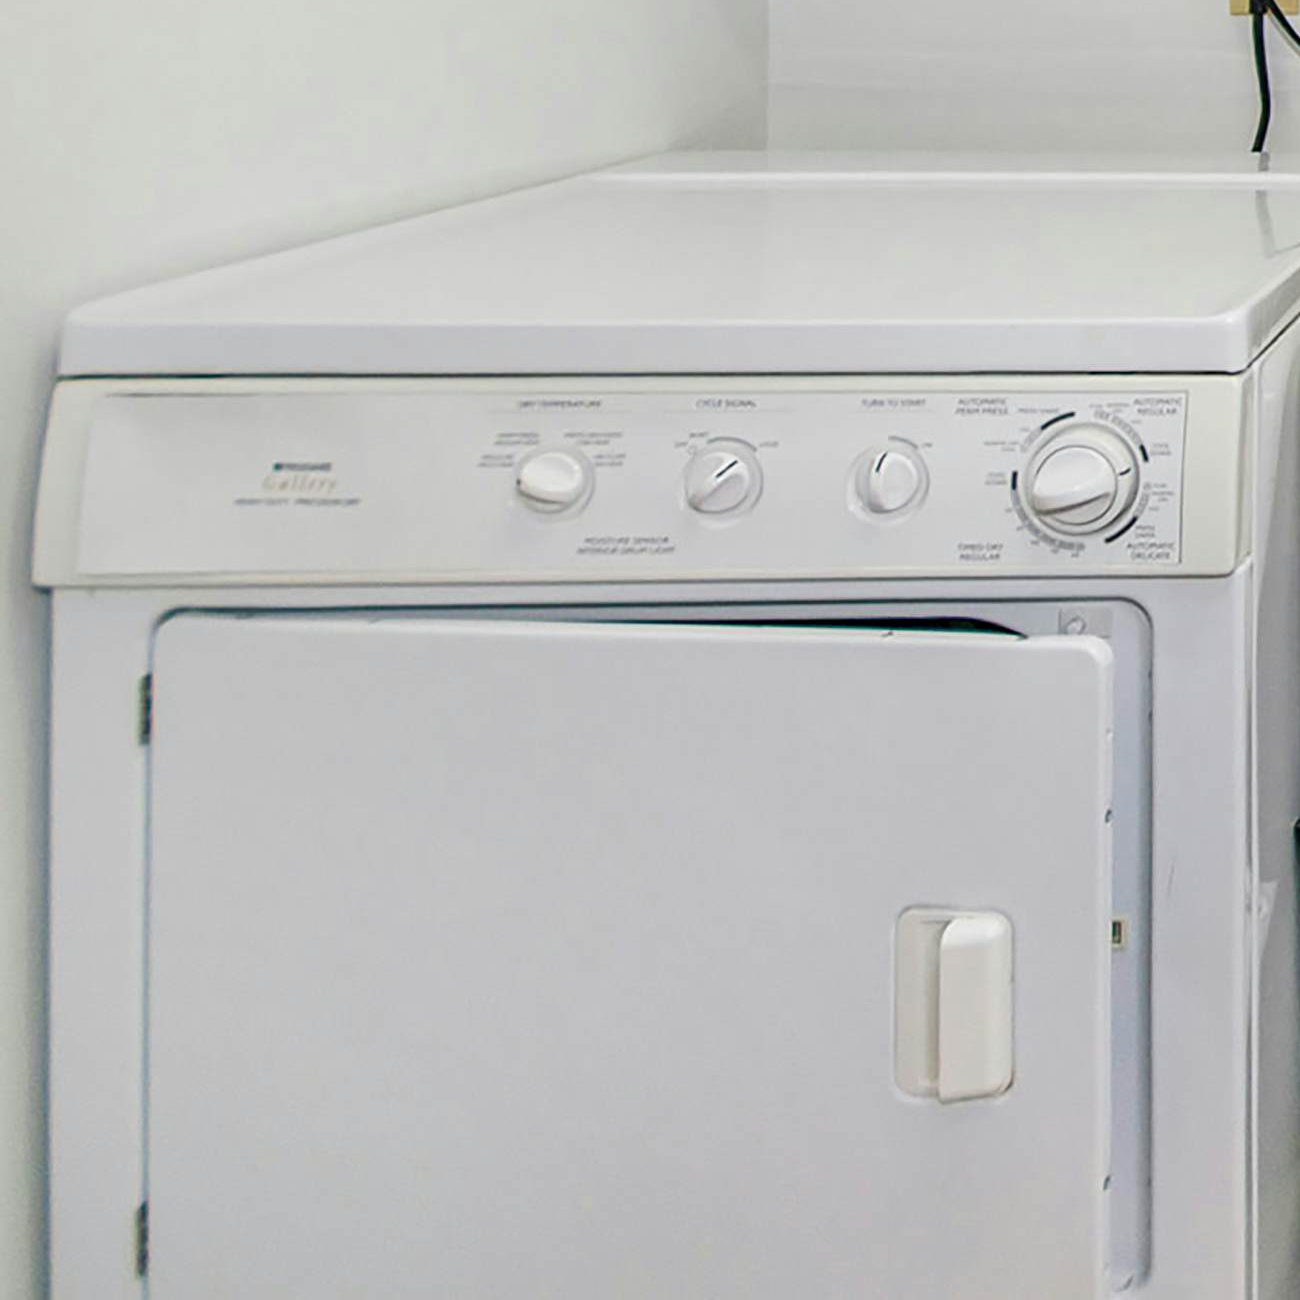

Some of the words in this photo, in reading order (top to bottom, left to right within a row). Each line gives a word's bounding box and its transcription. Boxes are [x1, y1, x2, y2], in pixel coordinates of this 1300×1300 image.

[1134, 397, 1182, 406] AUTOMATIC
[262, 474, 337, 495] Gallery
[1127, 542, 1175, 550] AUTOMATIC
